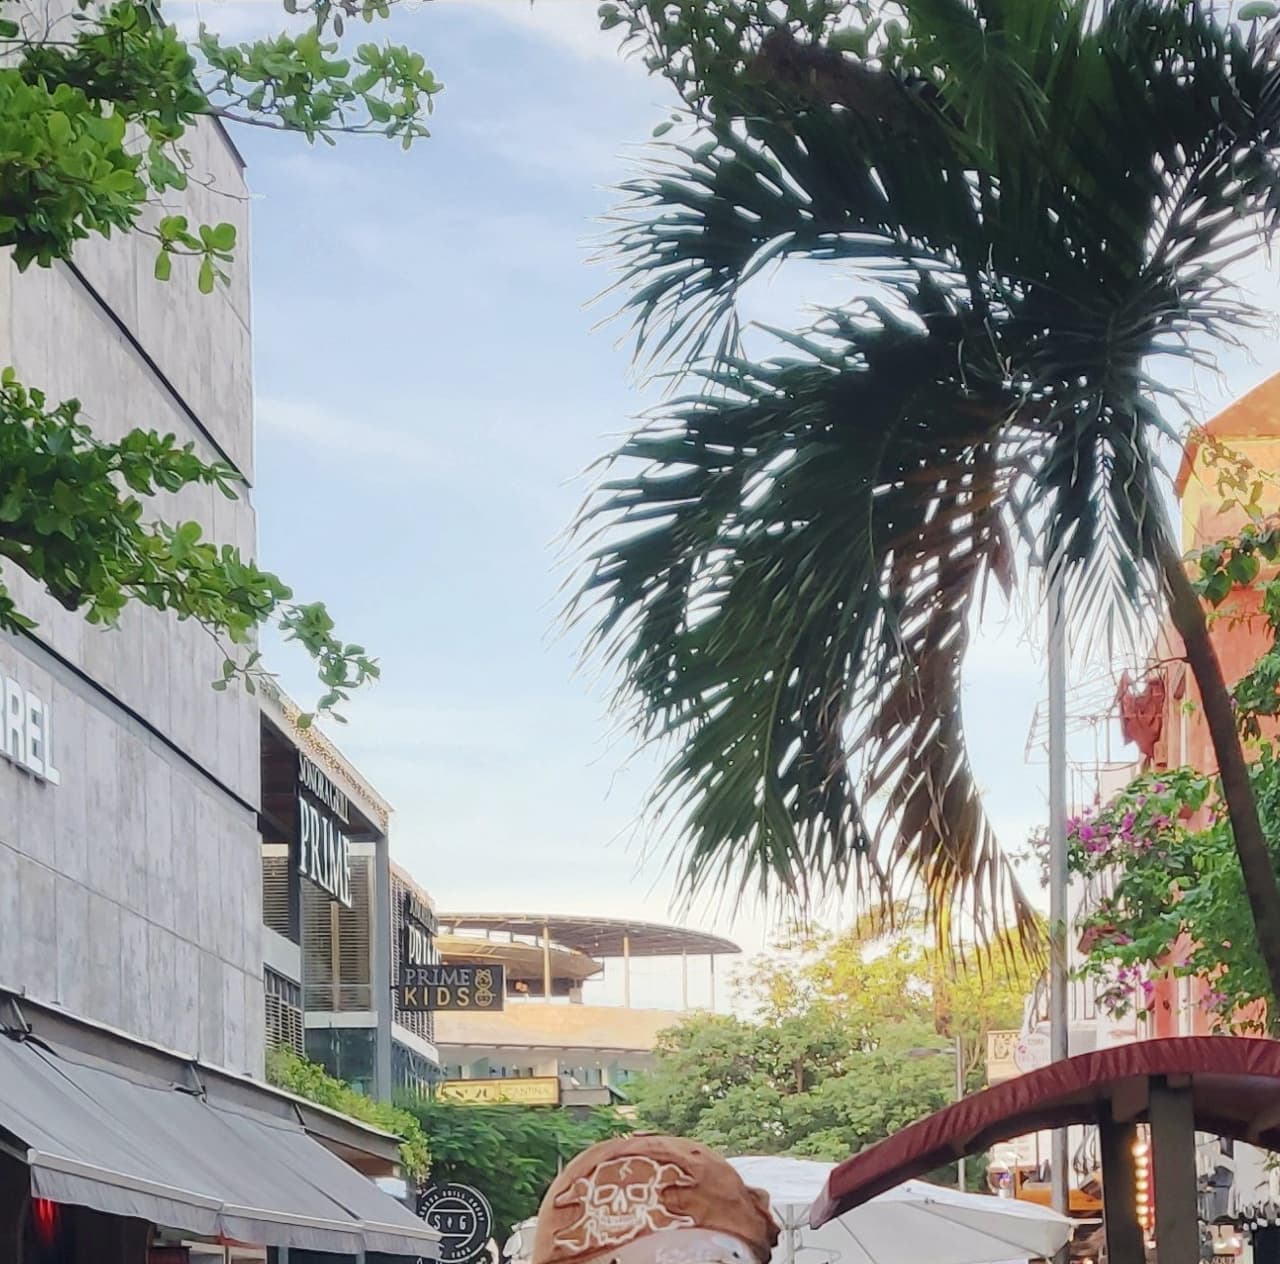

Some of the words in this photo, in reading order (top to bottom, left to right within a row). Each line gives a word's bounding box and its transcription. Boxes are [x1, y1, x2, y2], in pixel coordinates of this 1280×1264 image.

[298, 796, 353, 908] PRIME
[405, 968, 471, 986] PRIME
[405, 987, 470, 1006] KIDS
